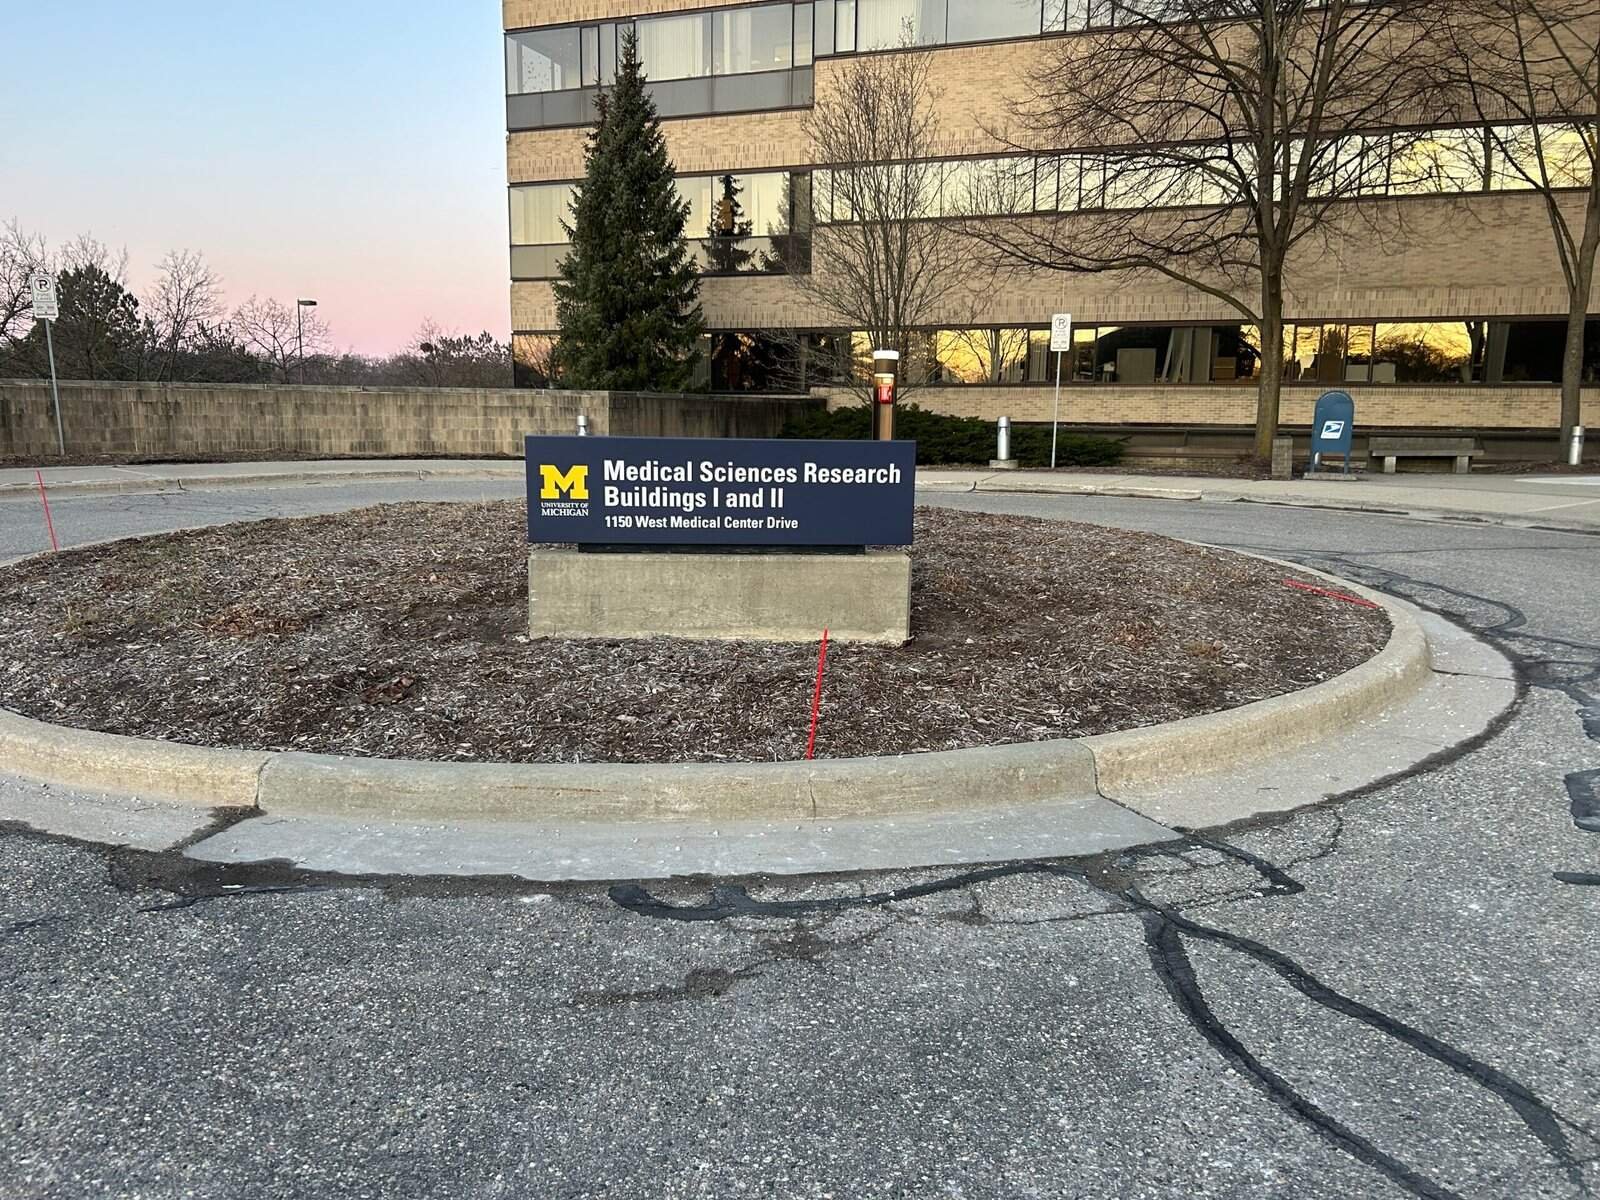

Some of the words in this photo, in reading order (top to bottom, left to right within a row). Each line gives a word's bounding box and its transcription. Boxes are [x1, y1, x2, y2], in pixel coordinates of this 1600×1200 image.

[540, 464, 590, 499] M
[604, 459, 693, 483] Medical
[700, 461, 797, 484] Sciences
[803, 463, 901, 485] Research
[541, 508, 589, 517] MICHIGAN
[604, 486, 707, 513] Buildings
[713, 487, 719, 508] I
[726, 488, 764, 509] and
[770, 488, 785, 508] II
[604, 515, 633, 528] 1150
[634, 516, 667, 529] West
[670, 516, 720, 529] Medical
[723, 516, 764, 529] Center
[766, 516, 799, 529] Drive
